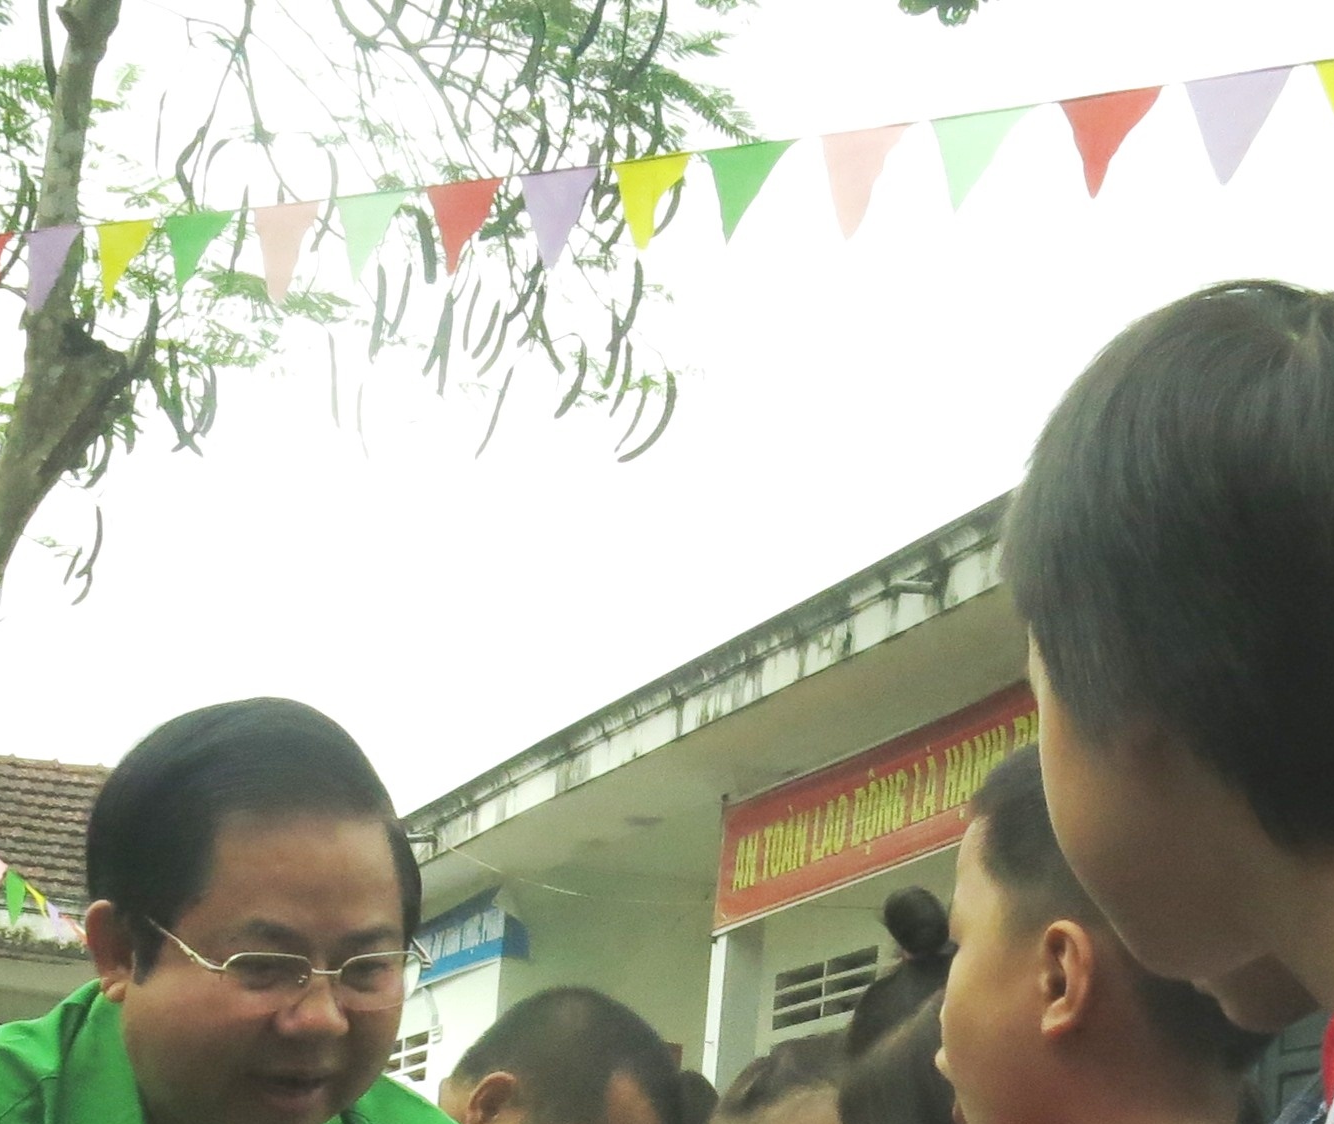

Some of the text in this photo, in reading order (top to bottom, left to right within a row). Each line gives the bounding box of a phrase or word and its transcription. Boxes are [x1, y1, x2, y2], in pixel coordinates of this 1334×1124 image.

[732, 830, 760, 892] AN
[763, 805, 809, 881] TOÀN
[810, 793, 848, 862] LAO
[851, 768, 909, 855] ĐỘNG
[910, 746, 937, 823] LÀ
